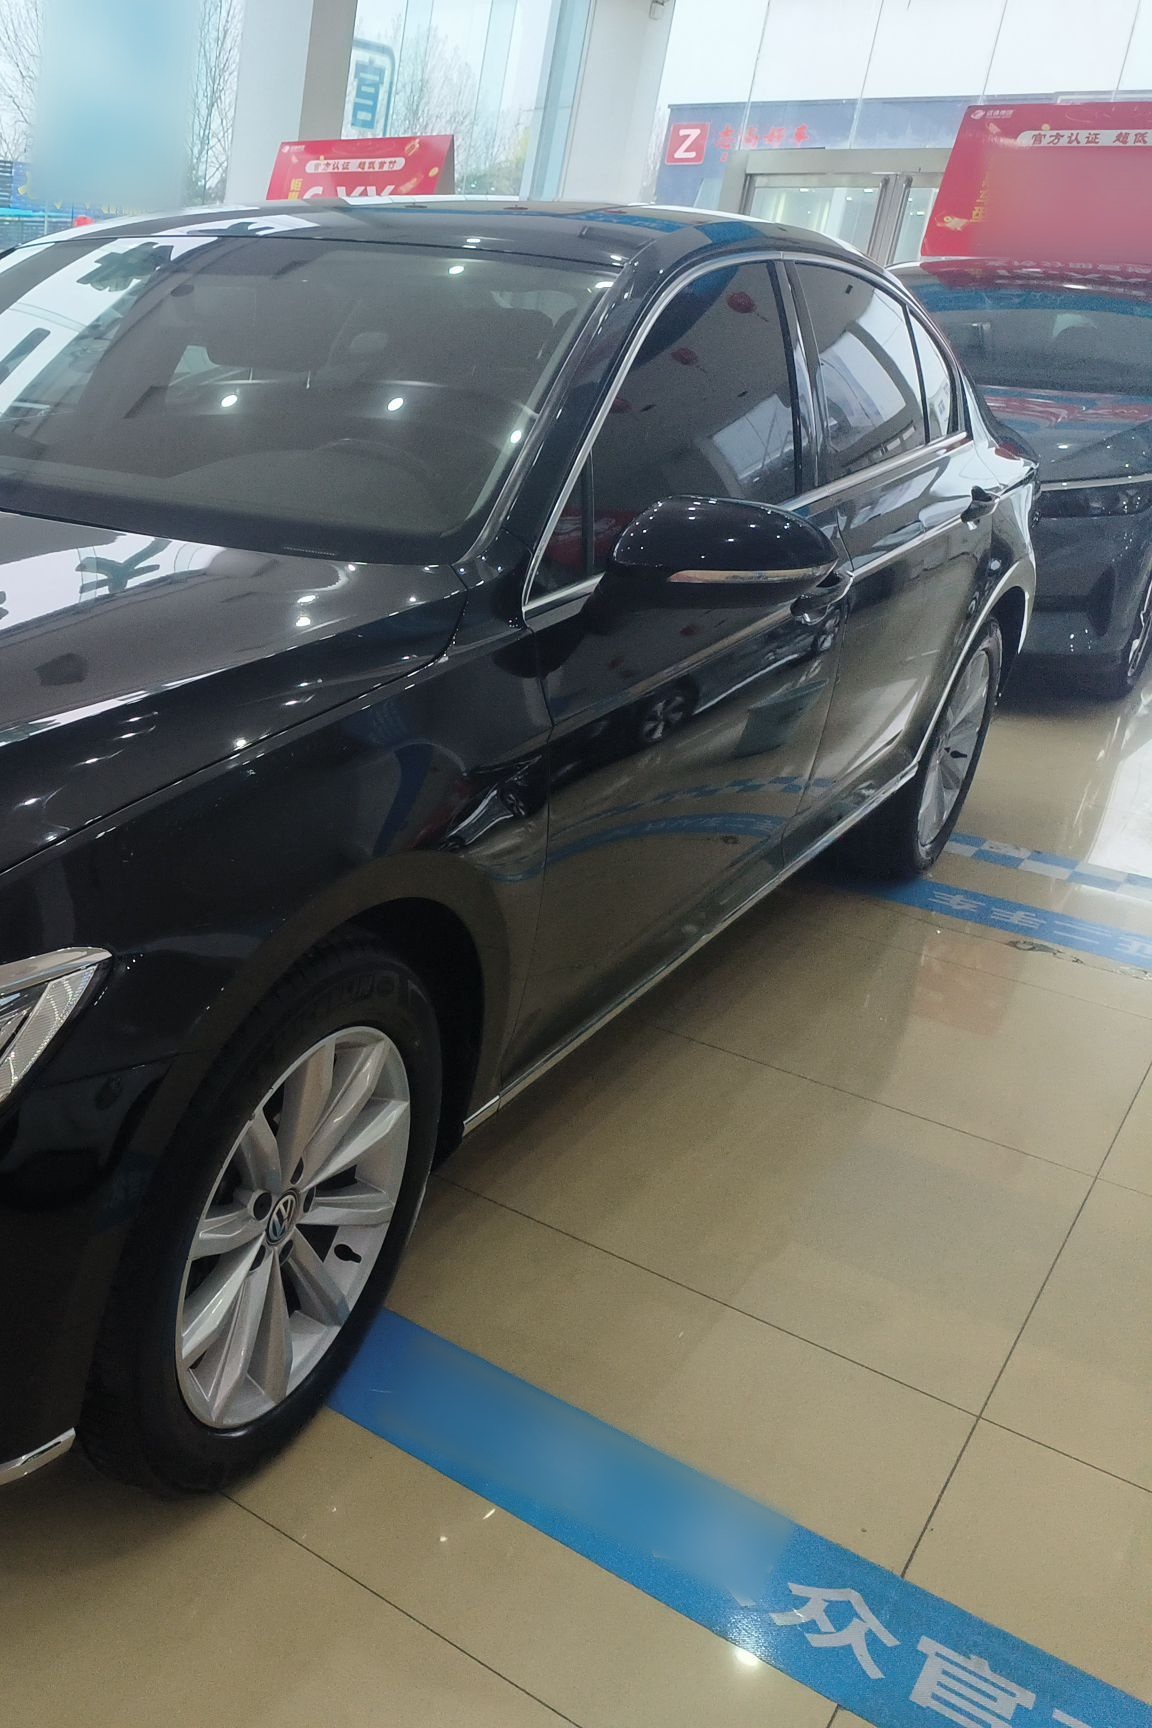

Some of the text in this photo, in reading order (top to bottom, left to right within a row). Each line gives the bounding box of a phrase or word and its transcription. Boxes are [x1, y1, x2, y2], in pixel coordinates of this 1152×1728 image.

[674, 129, 700, 158] Z
[1032, 132, 1100, 145] 官方认证
[770, 1582, 1091, 1728] 众官
